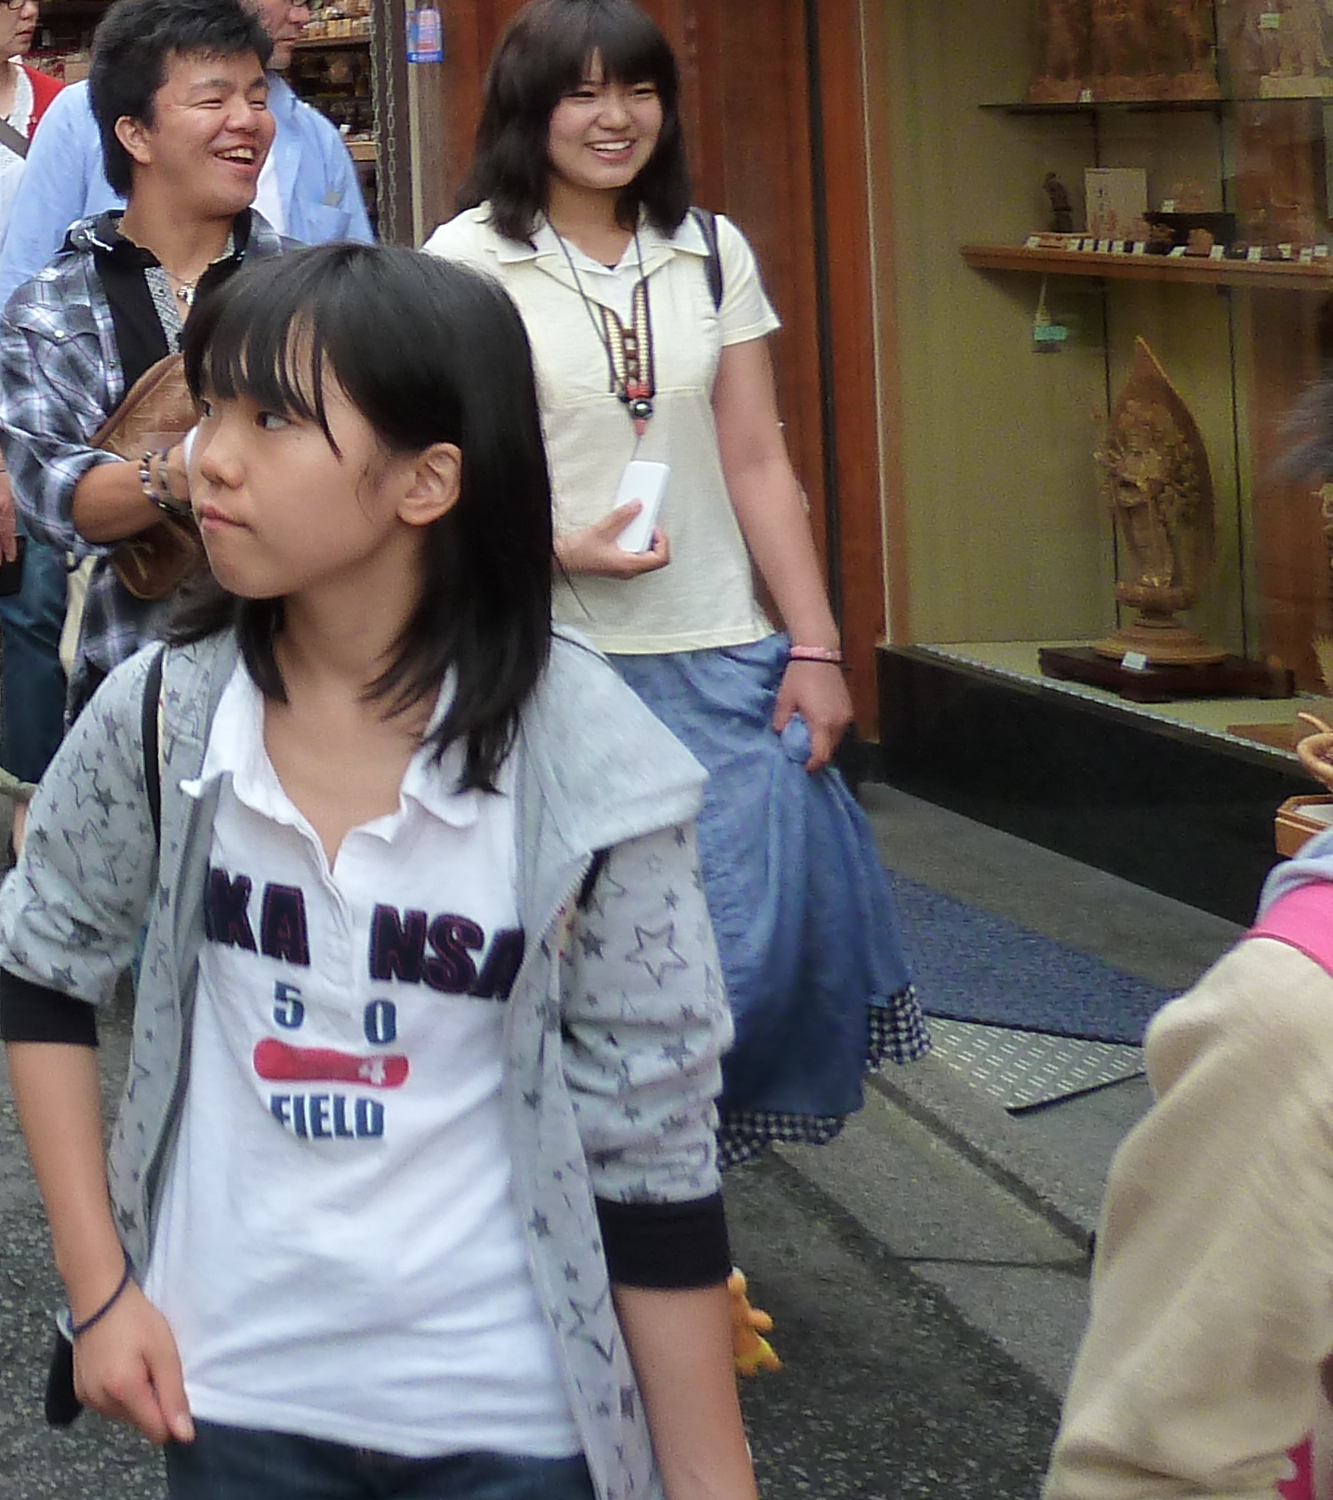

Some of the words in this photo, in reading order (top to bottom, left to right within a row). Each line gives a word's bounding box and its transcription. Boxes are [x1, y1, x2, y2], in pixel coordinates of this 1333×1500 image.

[271, 980, 305, 1030] 5
[362, 999, 398, 1046] 0
[269, 1094, 386, 1141] FIELD
